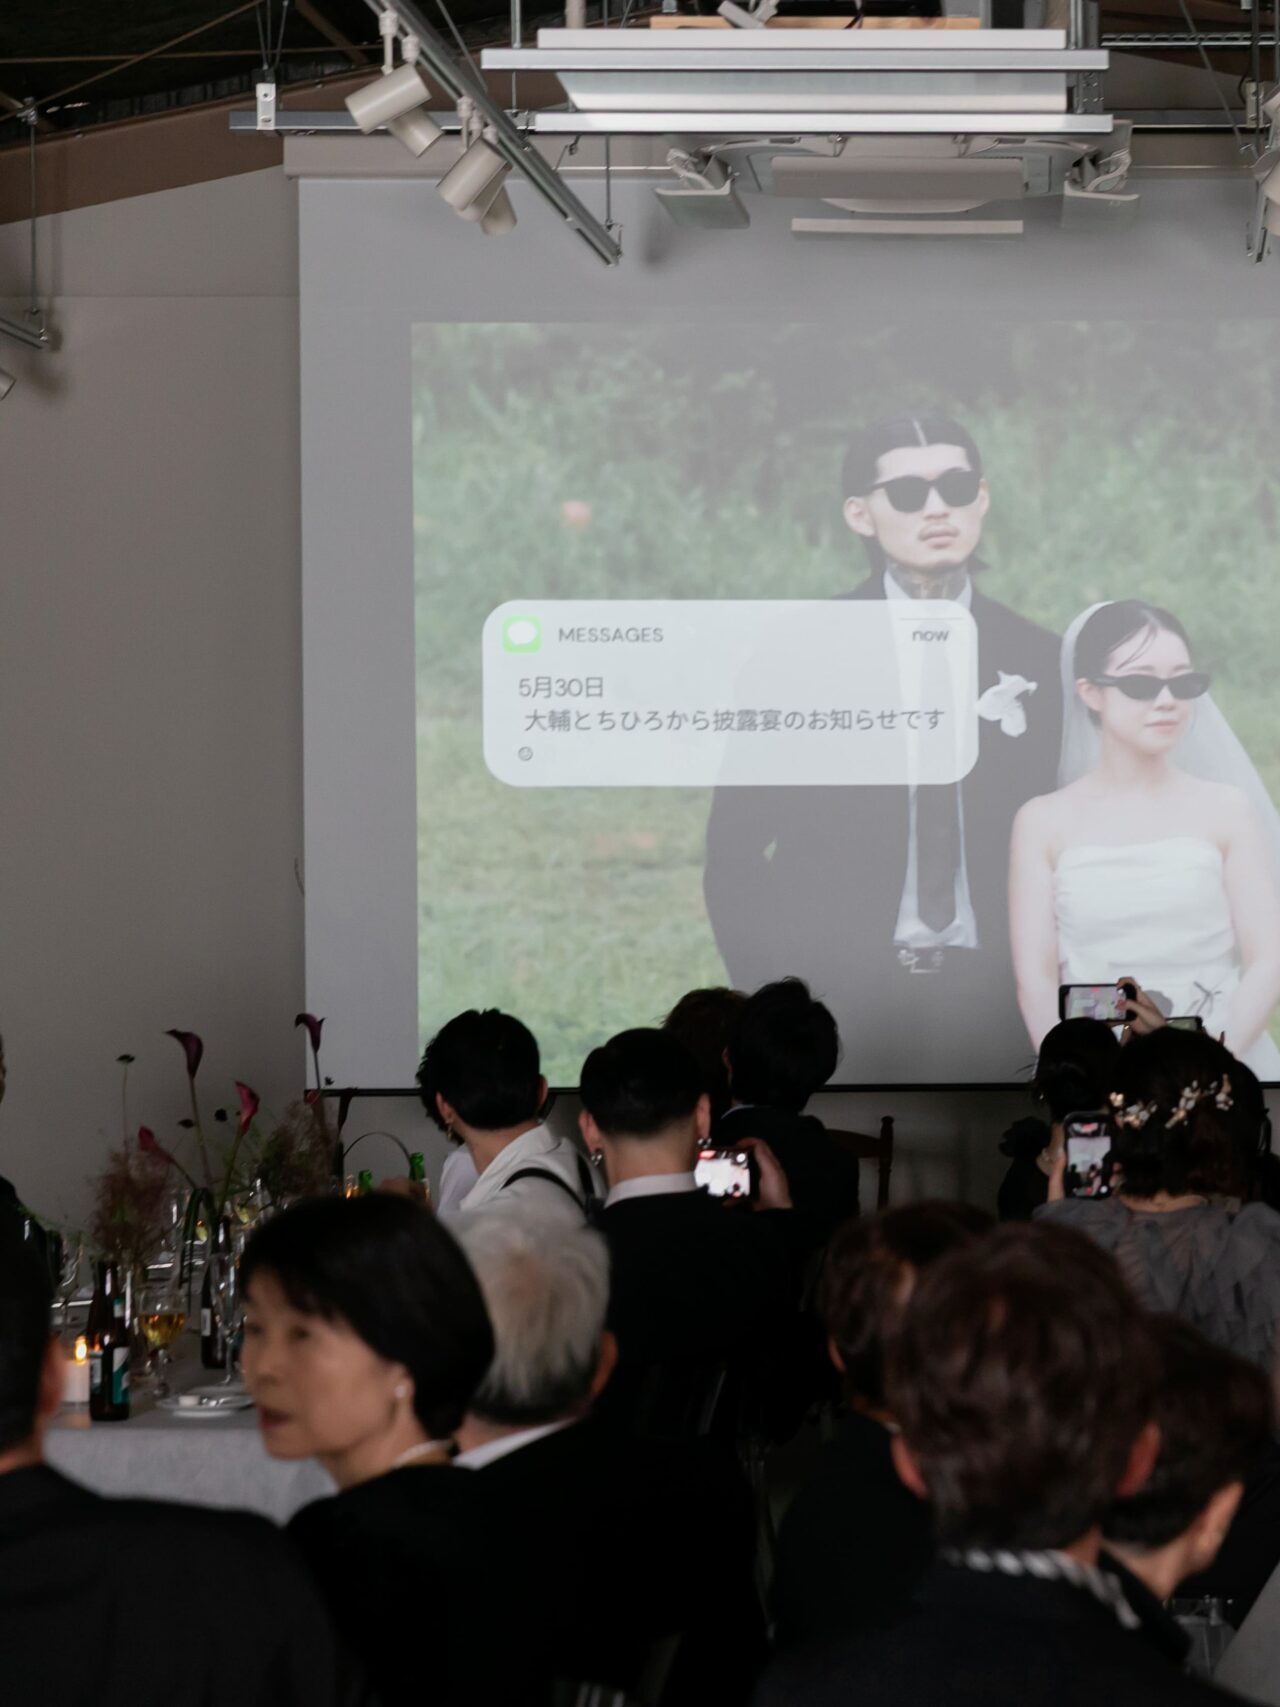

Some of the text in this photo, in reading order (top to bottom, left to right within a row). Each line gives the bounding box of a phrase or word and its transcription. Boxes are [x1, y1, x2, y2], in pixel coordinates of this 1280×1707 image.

[558, 627, 664, 643] MESSAGES
[912, 629, 949, 642] now
[518, 676, 604, 698] 5月30日
[524, 709, 944, 732] 大輔とちひろから披露宴のお知らせです
